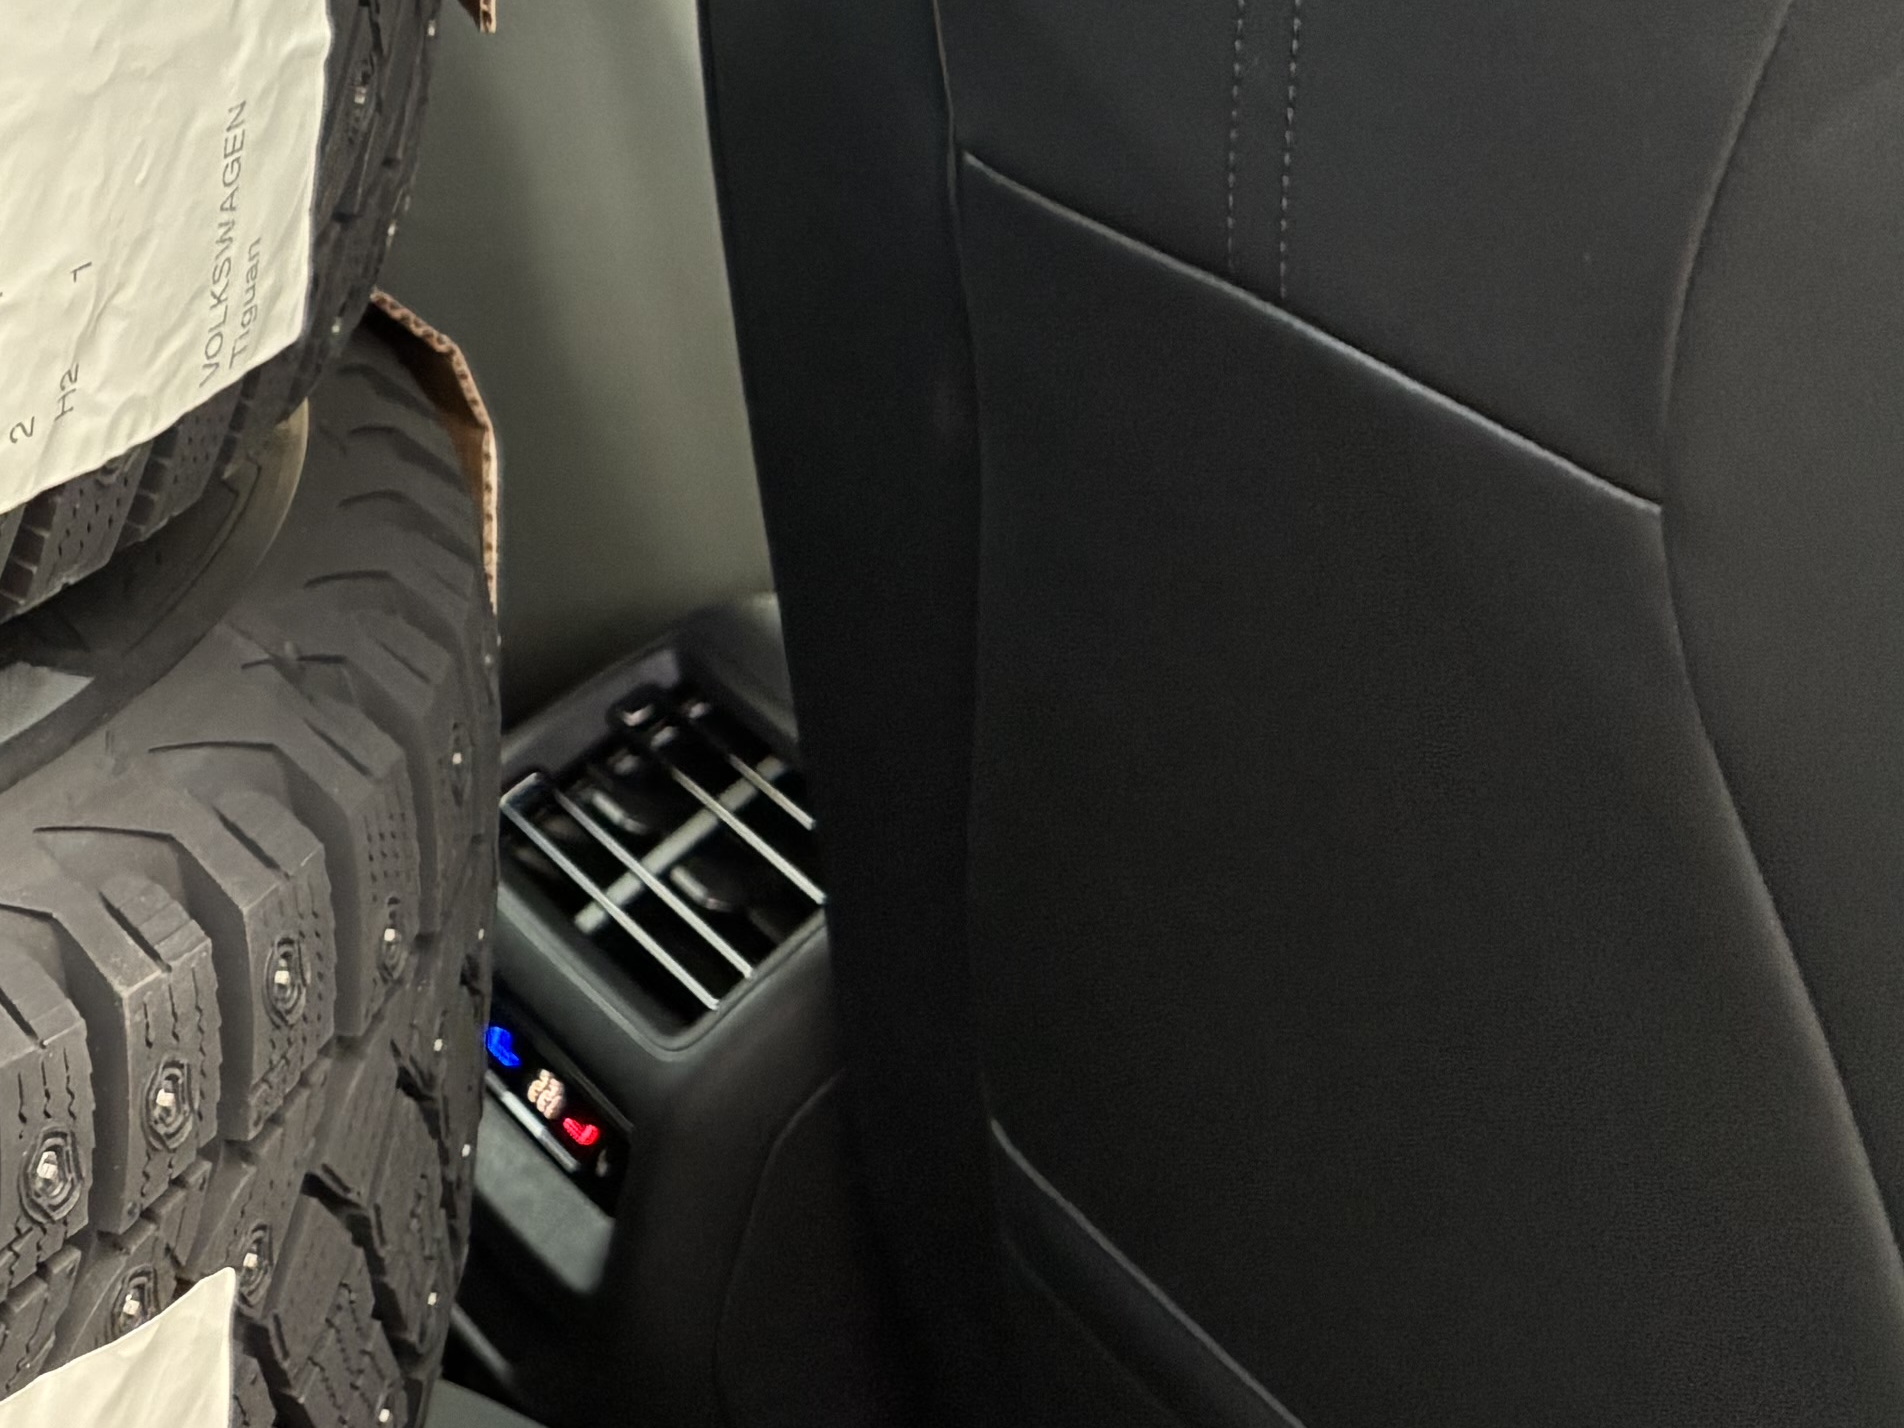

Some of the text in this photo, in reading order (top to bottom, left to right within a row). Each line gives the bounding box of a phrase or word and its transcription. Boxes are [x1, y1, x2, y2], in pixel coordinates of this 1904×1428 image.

[199, 99, 246, 388] VOLKSWAGEN
[229, 237, 261, 369] Tiguan
[9, 416, 35, 444] 2
[54, 363, 80, 422] H2
